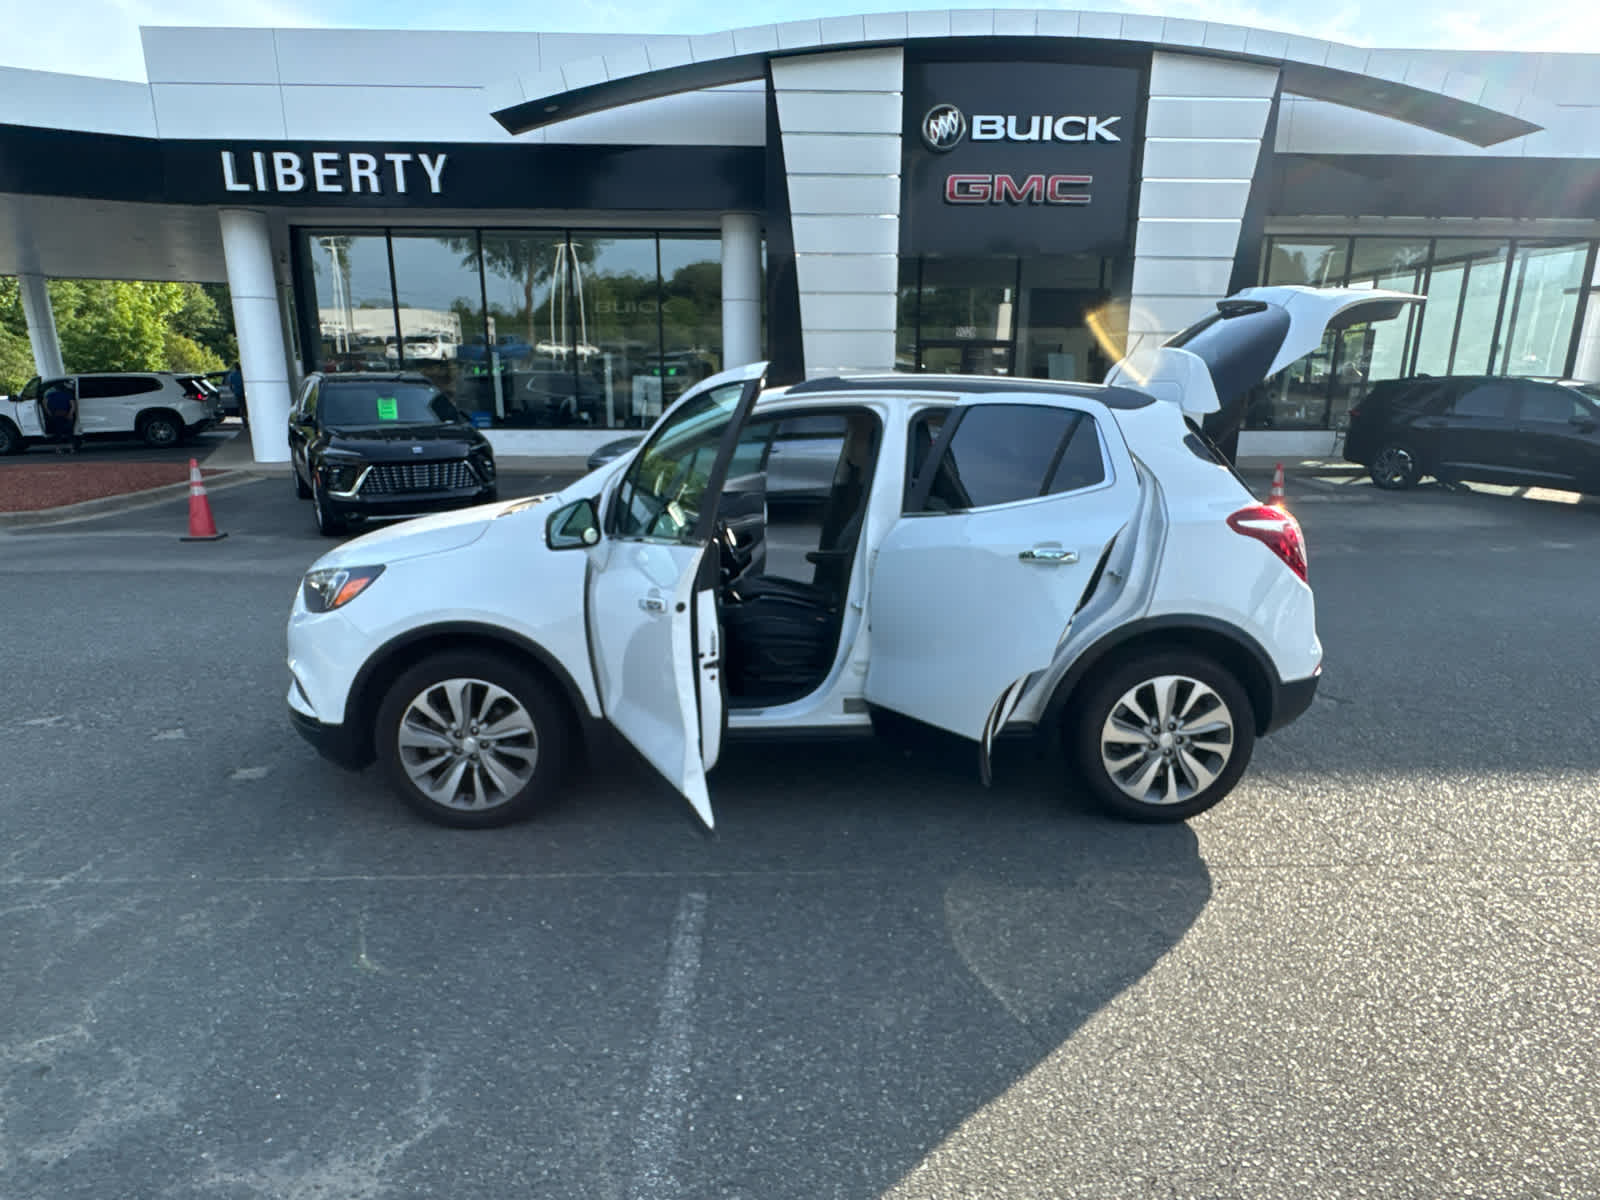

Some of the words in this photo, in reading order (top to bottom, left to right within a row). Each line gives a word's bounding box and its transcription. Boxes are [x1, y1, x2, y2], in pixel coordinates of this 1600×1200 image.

[971, 115, 1122, 142] BUICK
[220, 151, 448, 193] LIBERTY
[946, 173, 1093, 204] GMC
